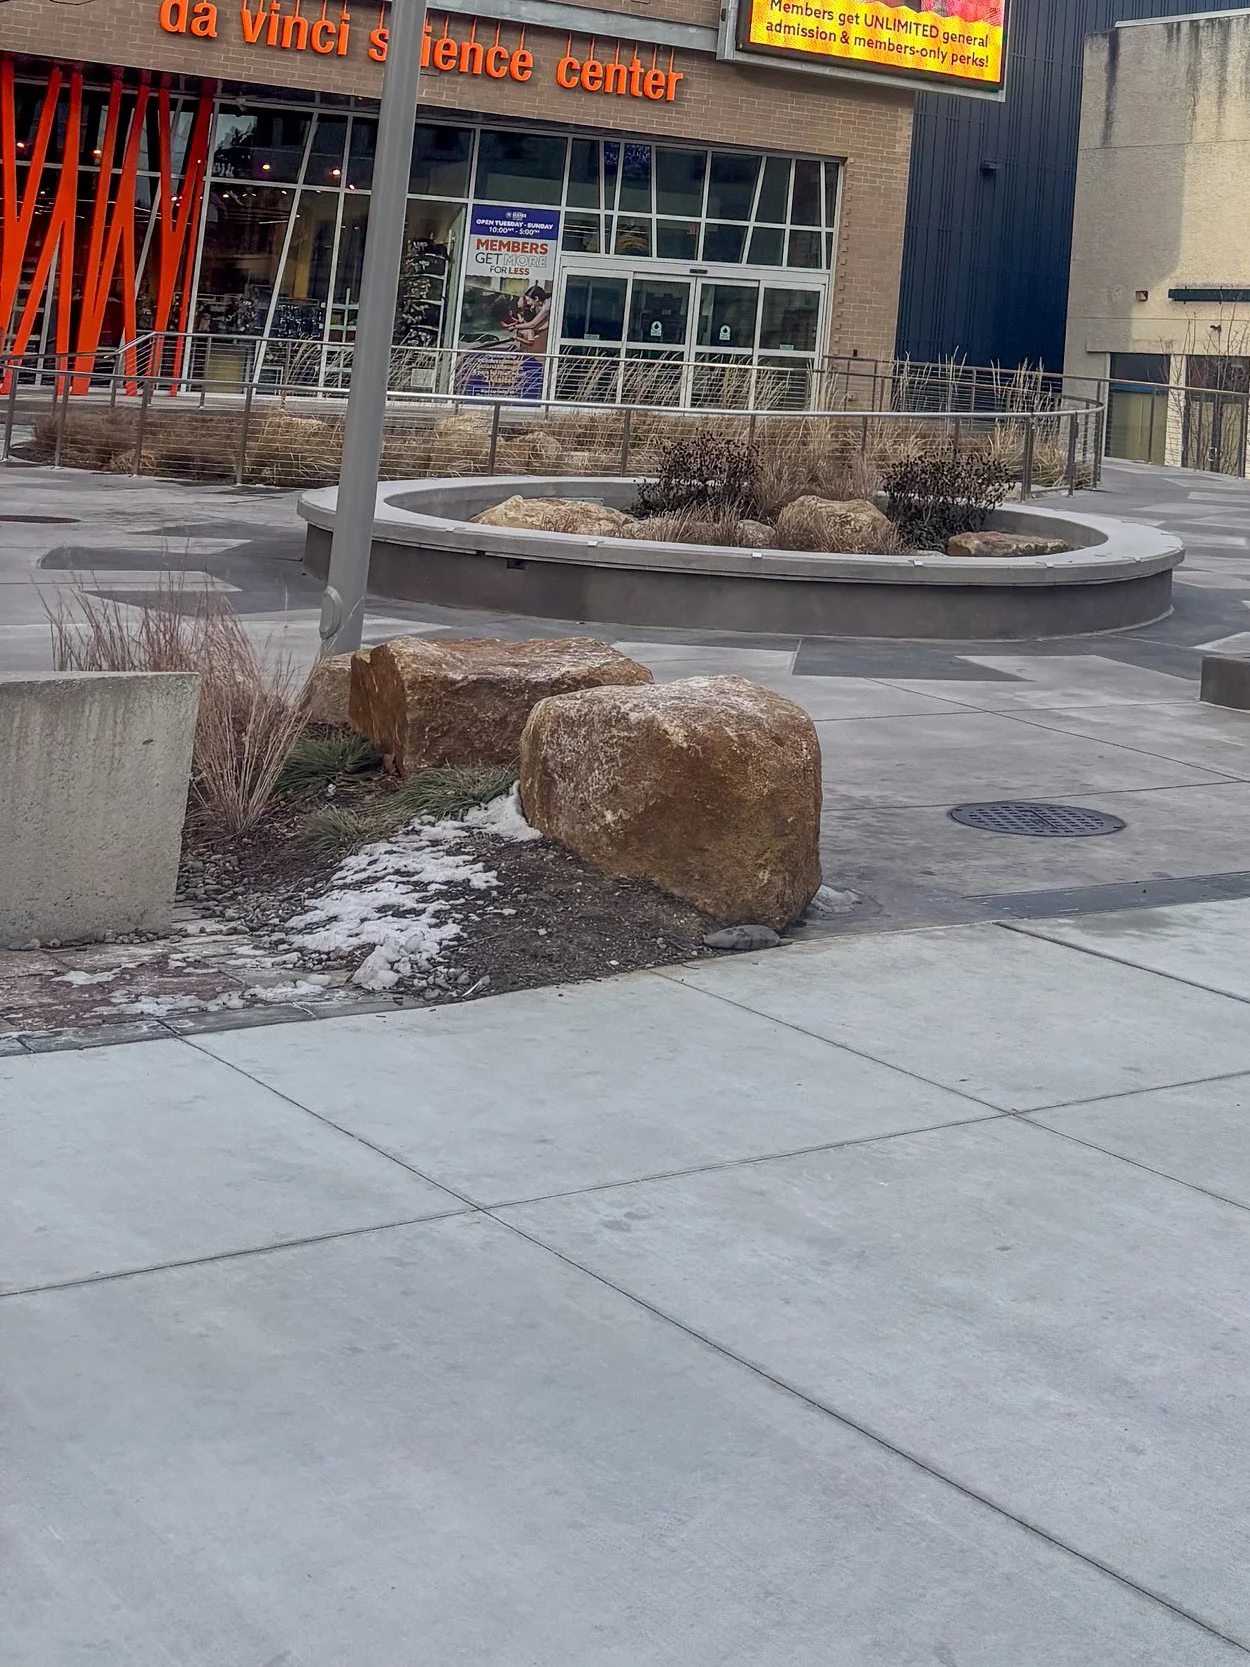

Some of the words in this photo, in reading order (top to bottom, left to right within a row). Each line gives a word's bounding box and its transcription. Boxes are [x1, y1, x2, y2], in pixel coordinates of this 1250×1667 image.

[766, 20, 836, 42] admission
[840, 31, 849, 44] &
[854, 34, 947, 62] members-only
[951, 52, 989, 68] perks!
[838, 11, 859, 26] get
[864, 14, 938, 38] UNLIMITED
[943, 30, 989, 47] general
[240, 0, 350, 56] vinci
[368, 14, 533, 82] sience
[557, 55, 683, 101] center
[475, 253, 502, 264] GET
[504, 254, 546, 267] MORE
[476, 239, 548, 254] MEMBERS
